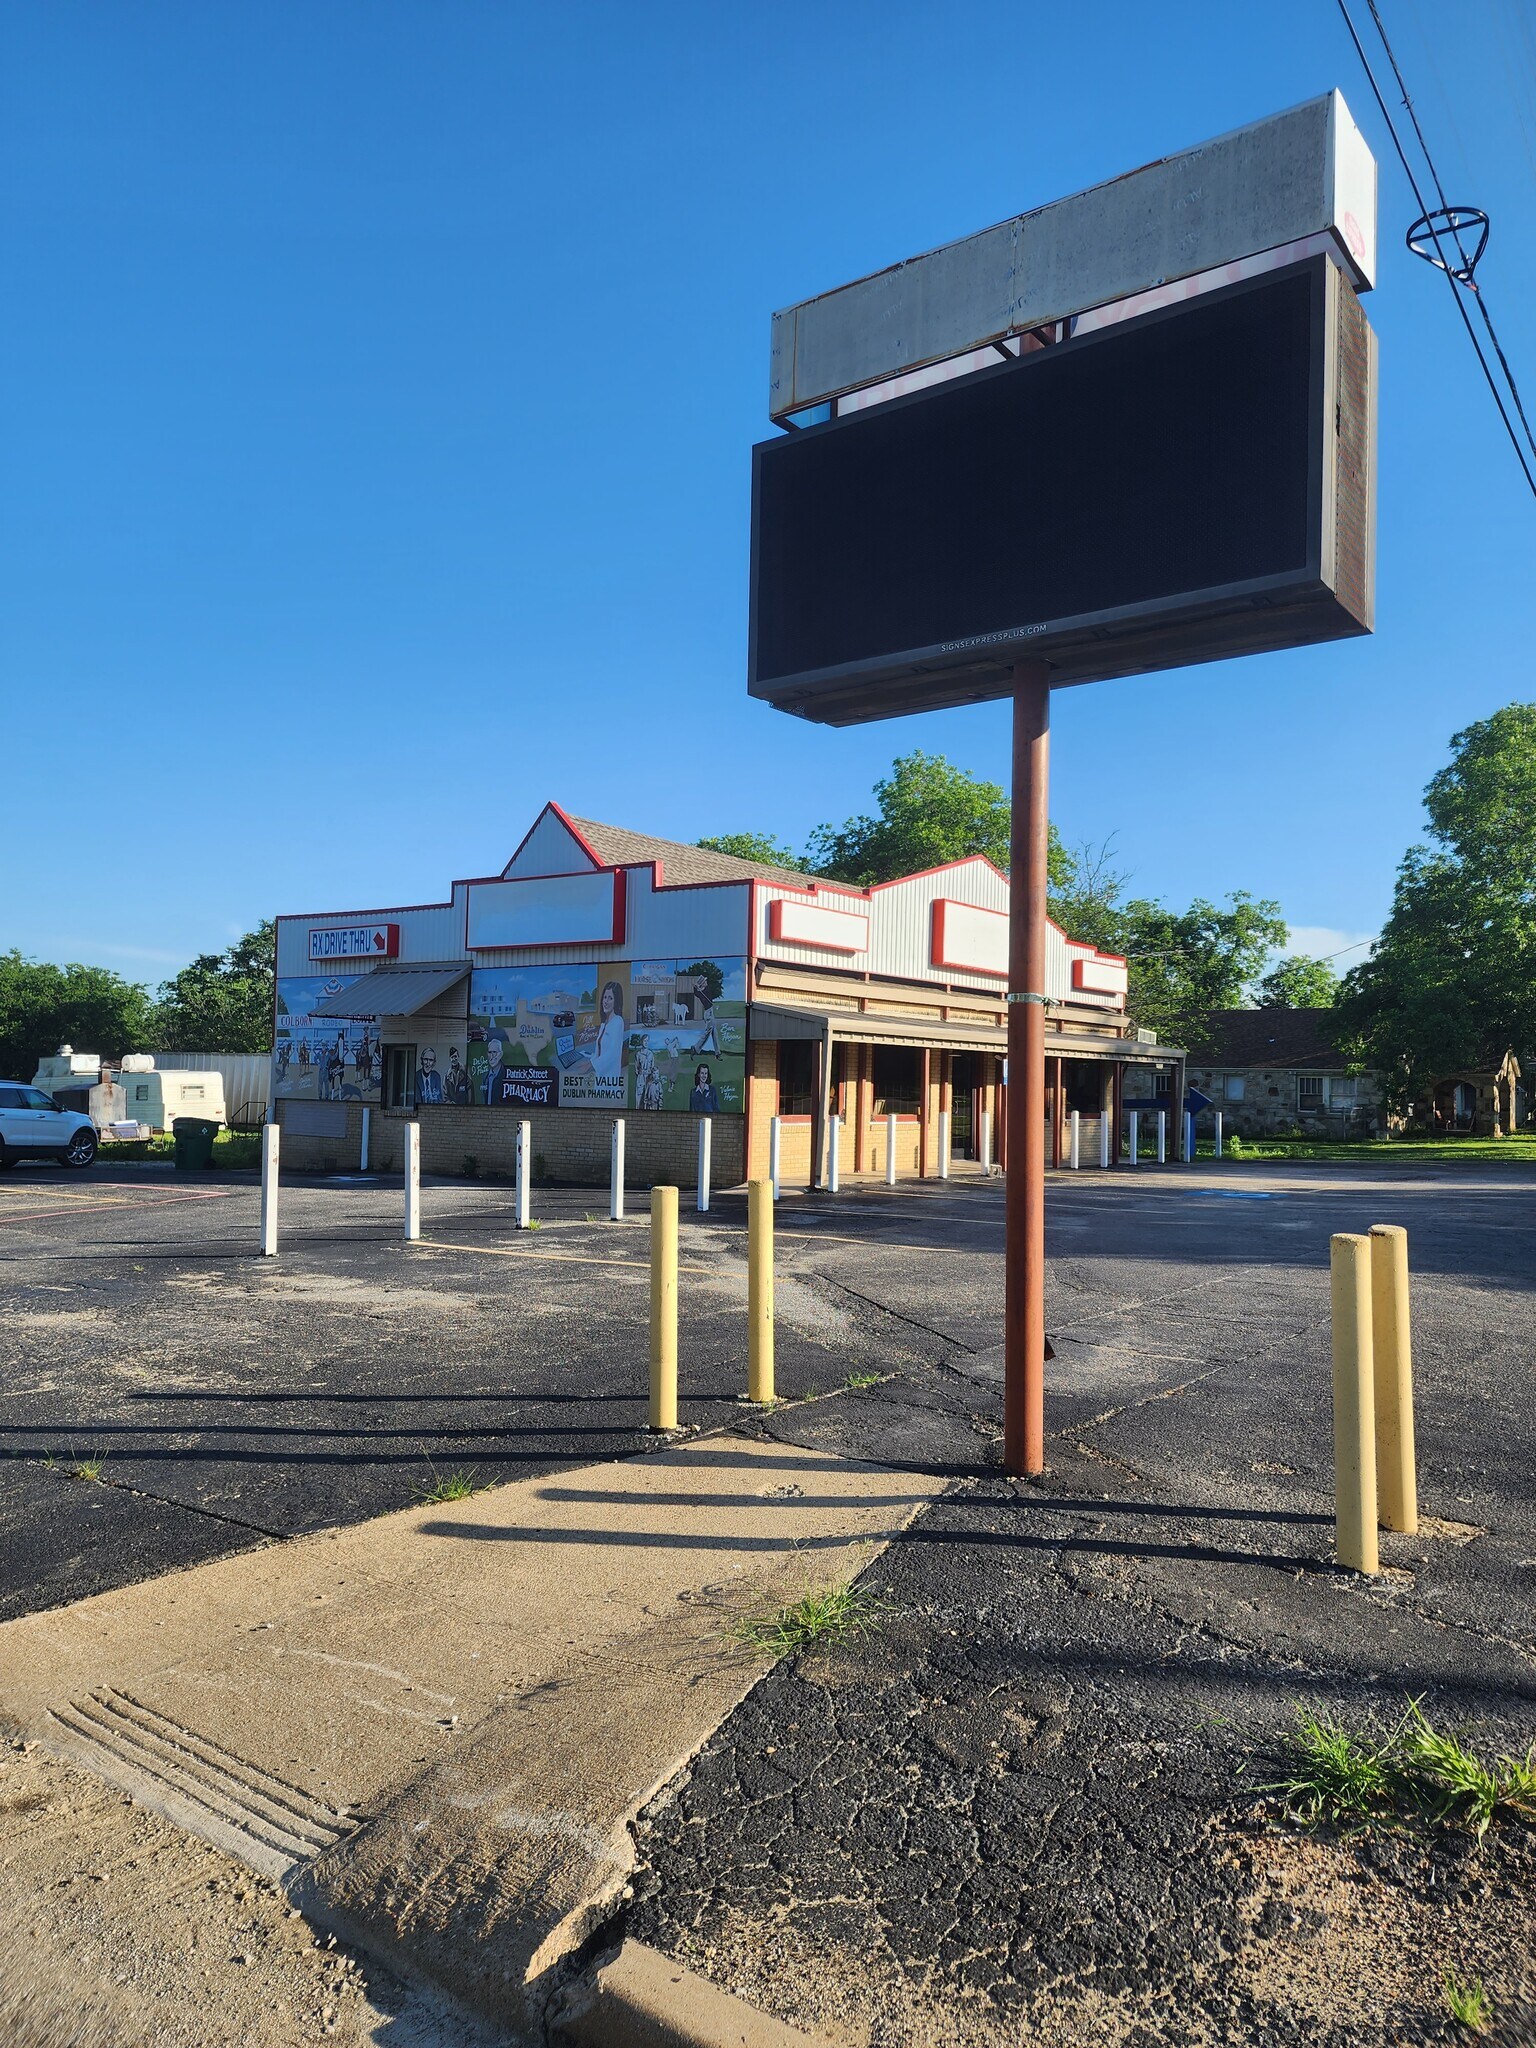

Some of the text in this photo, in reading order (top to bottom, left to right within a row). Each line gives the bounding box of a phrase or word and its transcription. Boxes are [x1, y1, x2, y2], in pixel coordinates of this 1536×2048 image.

[941, 624, 1047, 652] SIGNSEXPRESSPLUS.COM
[312, 929, 371, 956] RX DRIVE THRU
[506, 1068, 548, 1079] Patrick Street
[563, 1076, 625, 1087] BEST VALUE
[502, 1083, 551, 1103] PHARMACY
[562, 1088, 625, 1100] DUBLIN PHARMACY
